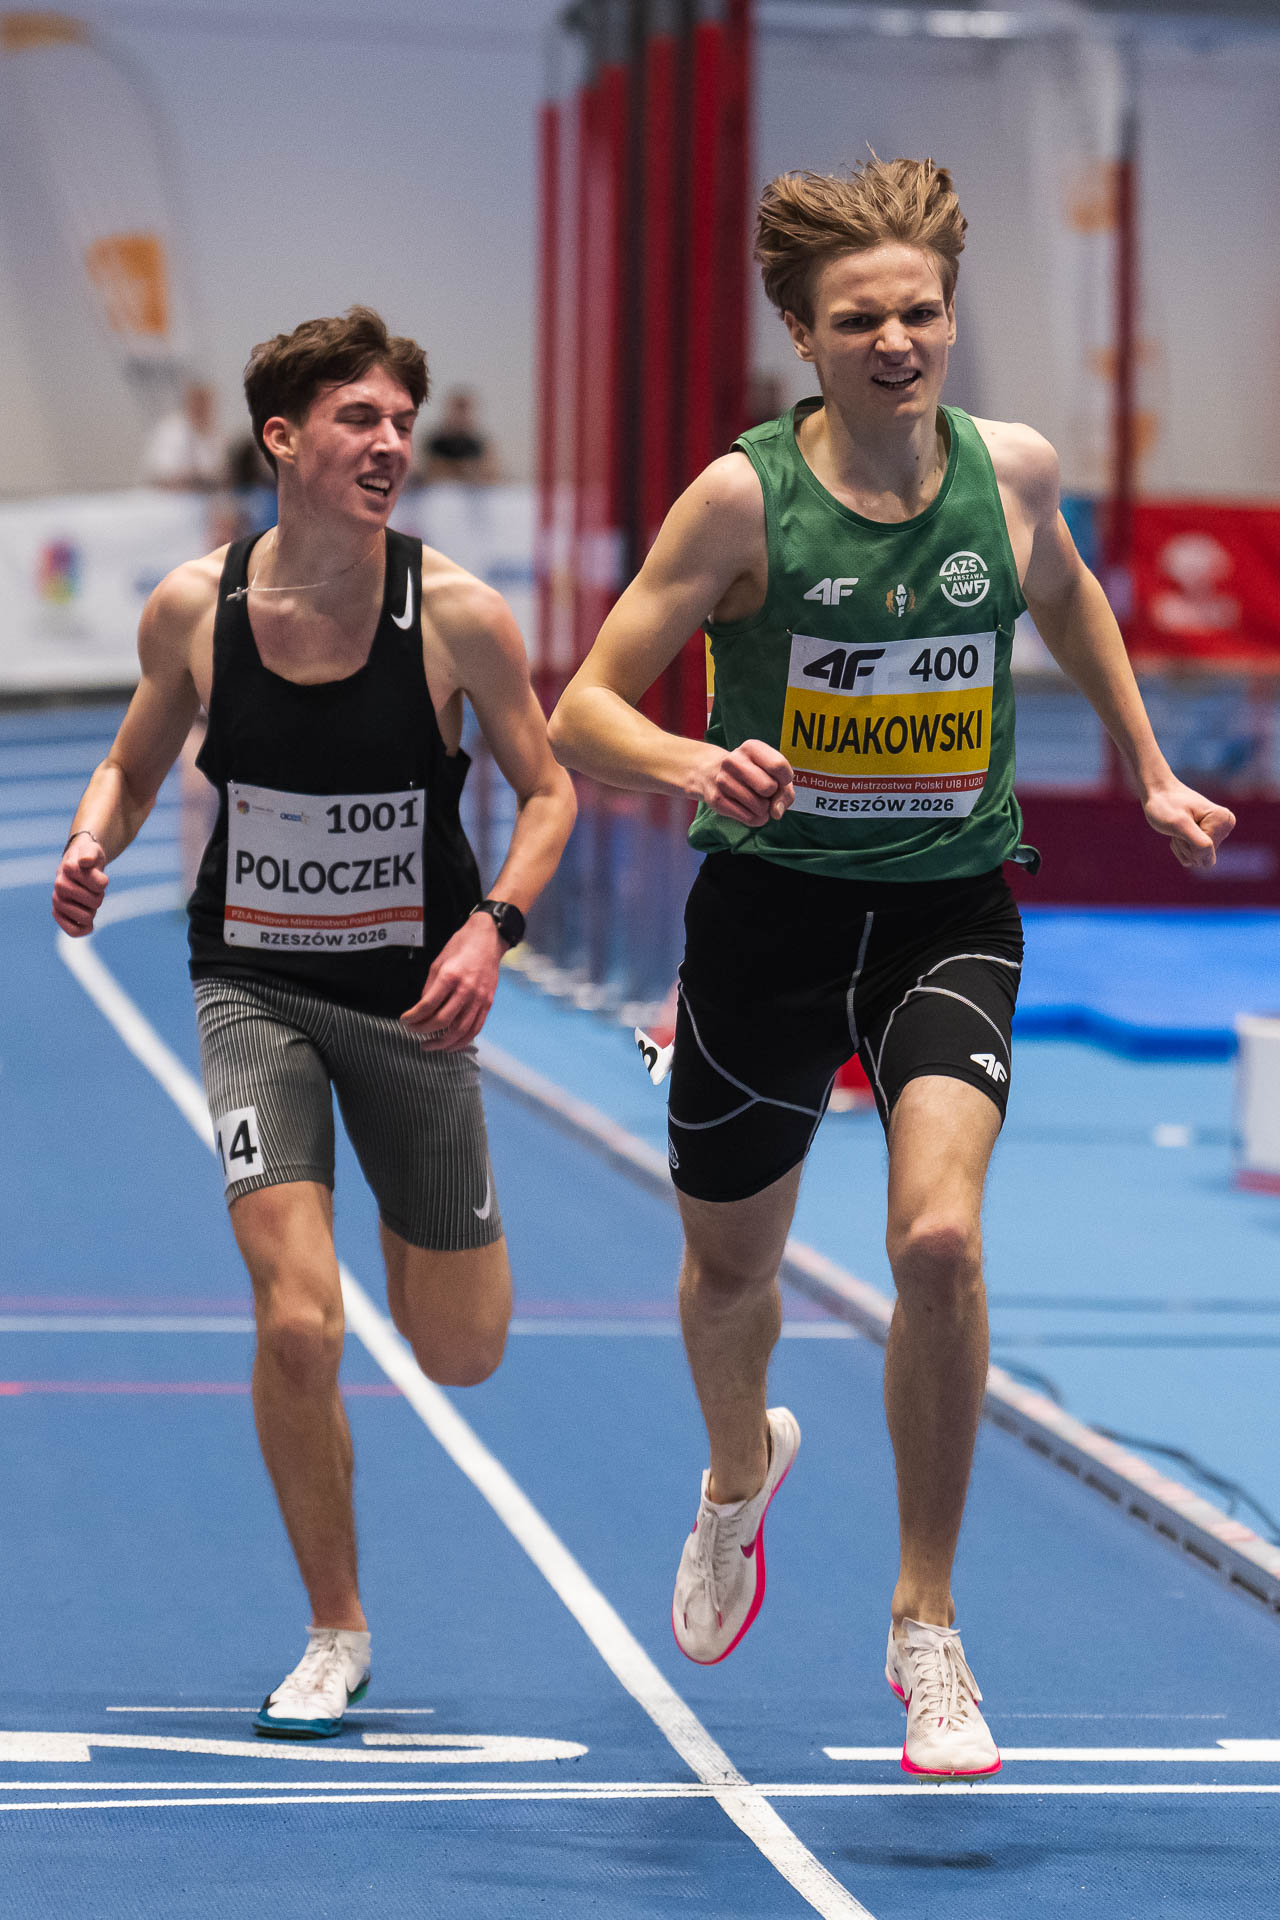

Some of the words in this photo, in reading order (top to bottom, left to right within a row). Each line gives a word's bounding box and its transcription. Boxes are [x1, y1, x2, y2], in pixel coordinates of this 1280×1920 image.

[946, 572, 985, 582] WARSZAWA
[949, 558, 978, 576] AZS
[803, 577, 859, 606] 4F
[951, 579, 983, 597] AWF
[803, 648, 886, 690] 4F
[909, 644, 979, 682] 400
[791, 709, 983, 755] NIJAKOWSKI
[792, 774, 807, 784] ZLA
[810, 777, 849, 790] Halowe
[851, 779, 912, 790] Mistrzostwa
[915, 780, 943, 790] Polski
[945, 779, 961, 789] U18
[968, 775, 984, 787] U20
[815, 795, 906, 812] RZESZÓW
[910, 798, 954, 812] 2026
[325, 797, 418, 834] 1001
[235, 850, 416, 895] POLOCZEK
[260, 930, 343, 946] RZESZÓW
[348, 928, 387, 946] 2026
[970, 1052, 1008, 1084] 4F
